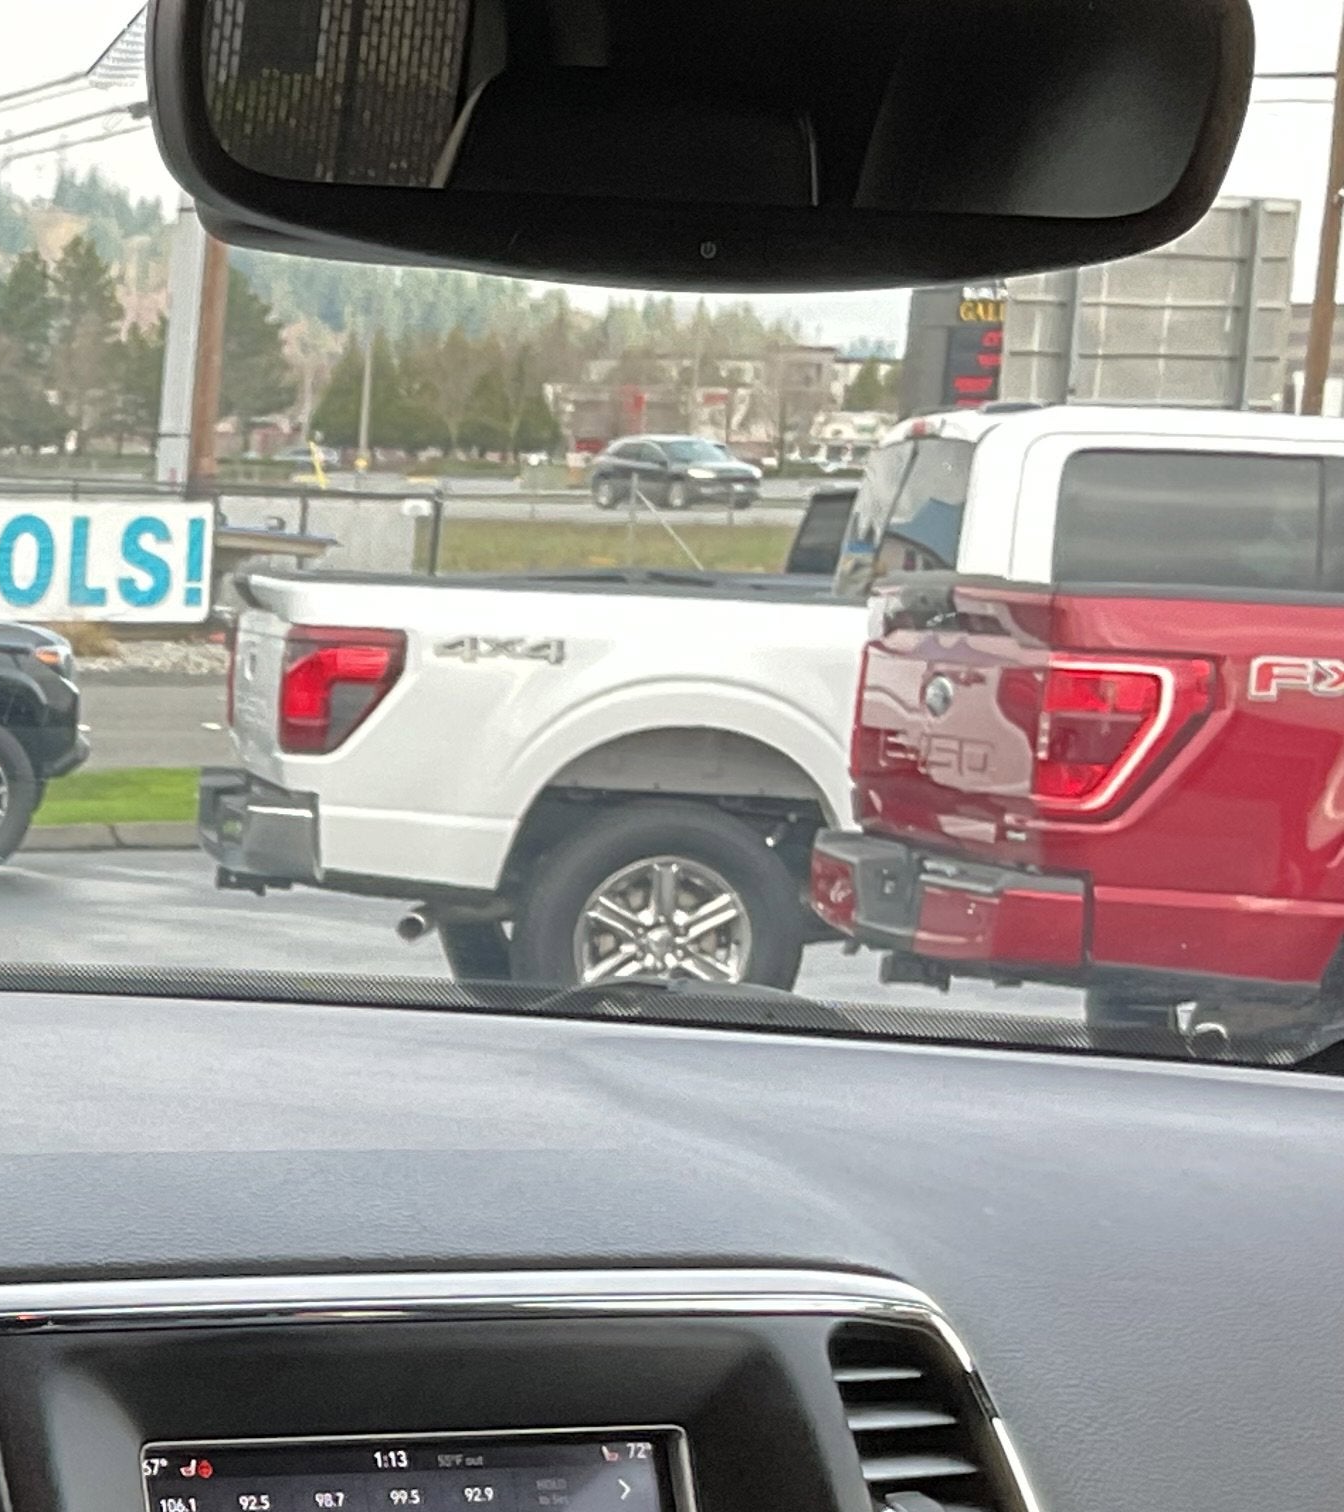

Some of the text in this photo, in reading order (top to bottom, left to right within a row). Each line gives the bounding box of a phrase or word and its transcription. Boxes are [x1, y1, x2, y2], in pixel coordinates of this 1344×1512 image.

[373, 1450, 408, 1469] 1:13
[238, 1494, 271, 1511] 92.5
[464, 1487, 495, 1502] 92.9
[160, 1498, 197, 1512] 106.1
